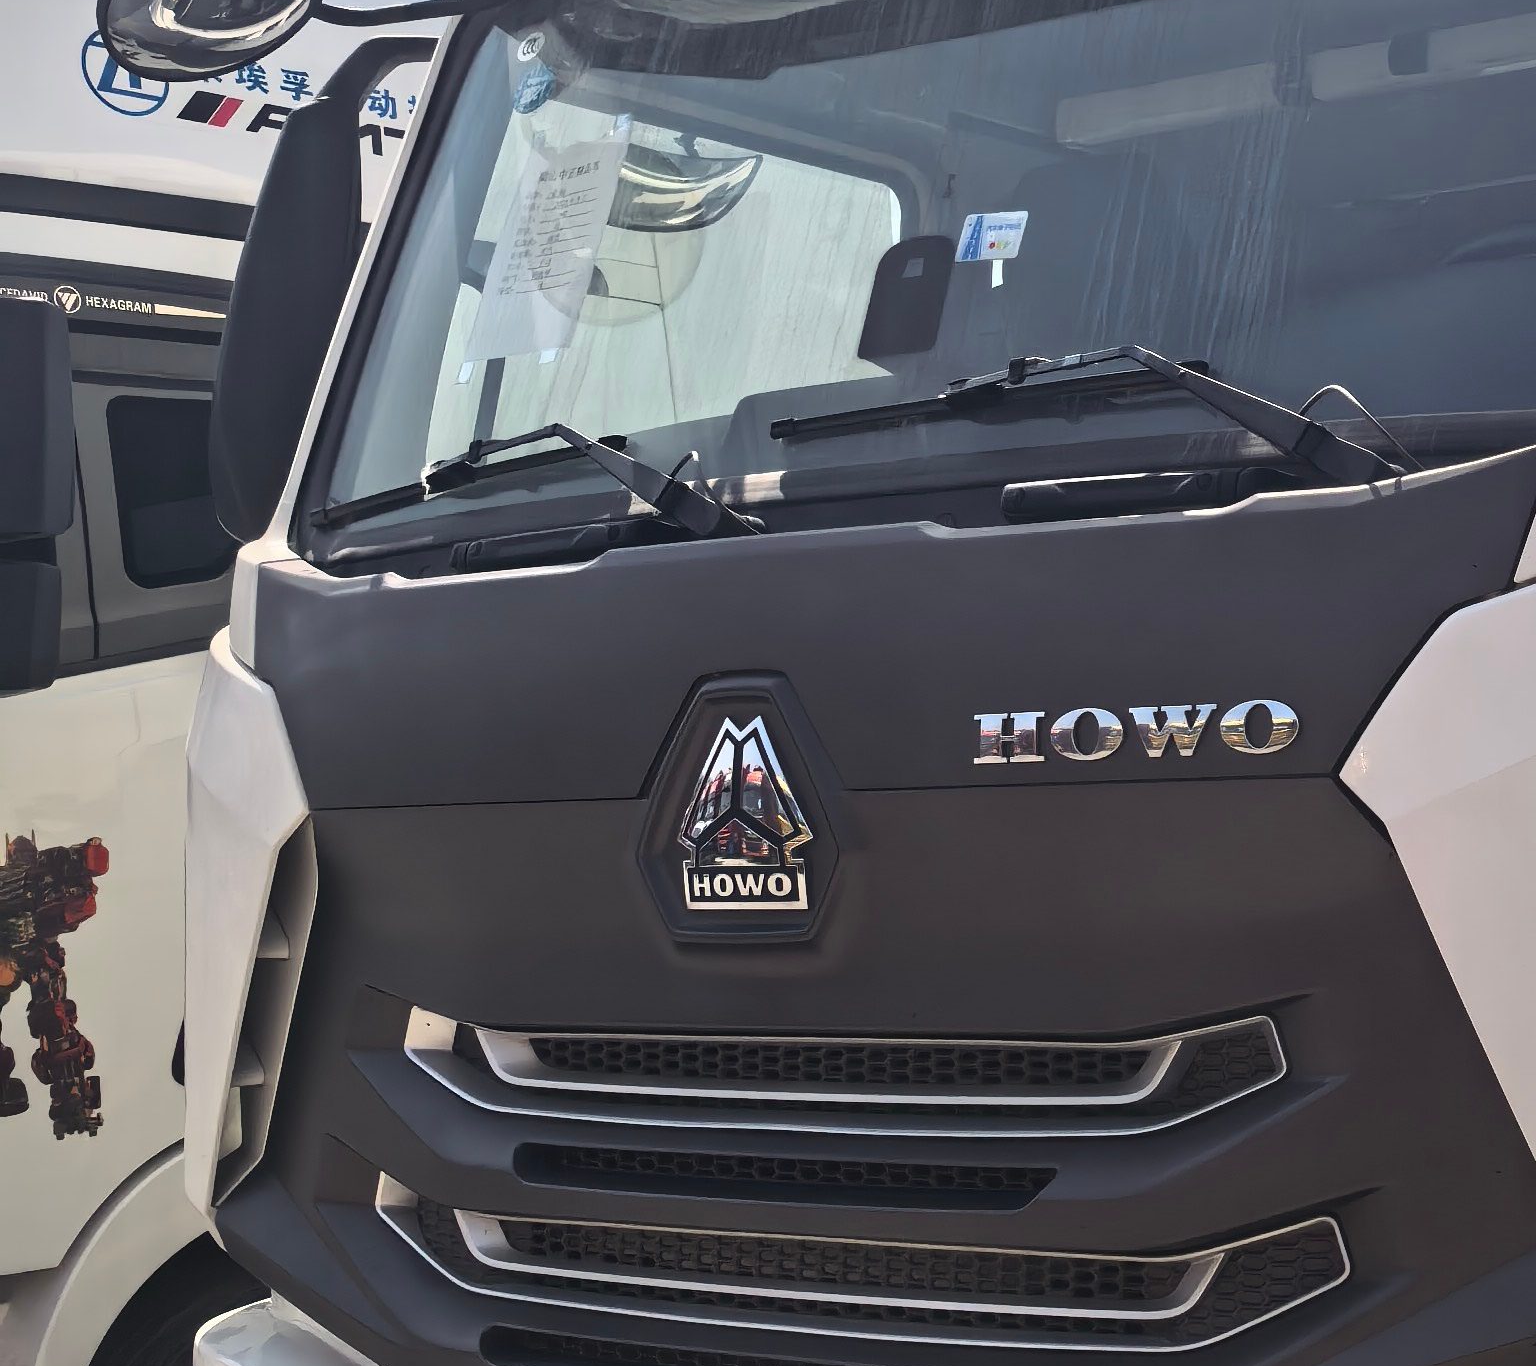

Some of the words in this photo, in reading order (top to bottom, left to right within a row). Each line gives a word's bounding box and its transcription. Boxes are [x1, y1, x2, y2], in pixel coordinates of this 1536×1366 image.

[85, 295, 152, 314] HEXAGRAM
[972, 698, 1300, 765] HOWO
[692, 871, 793, 898] HOWO
